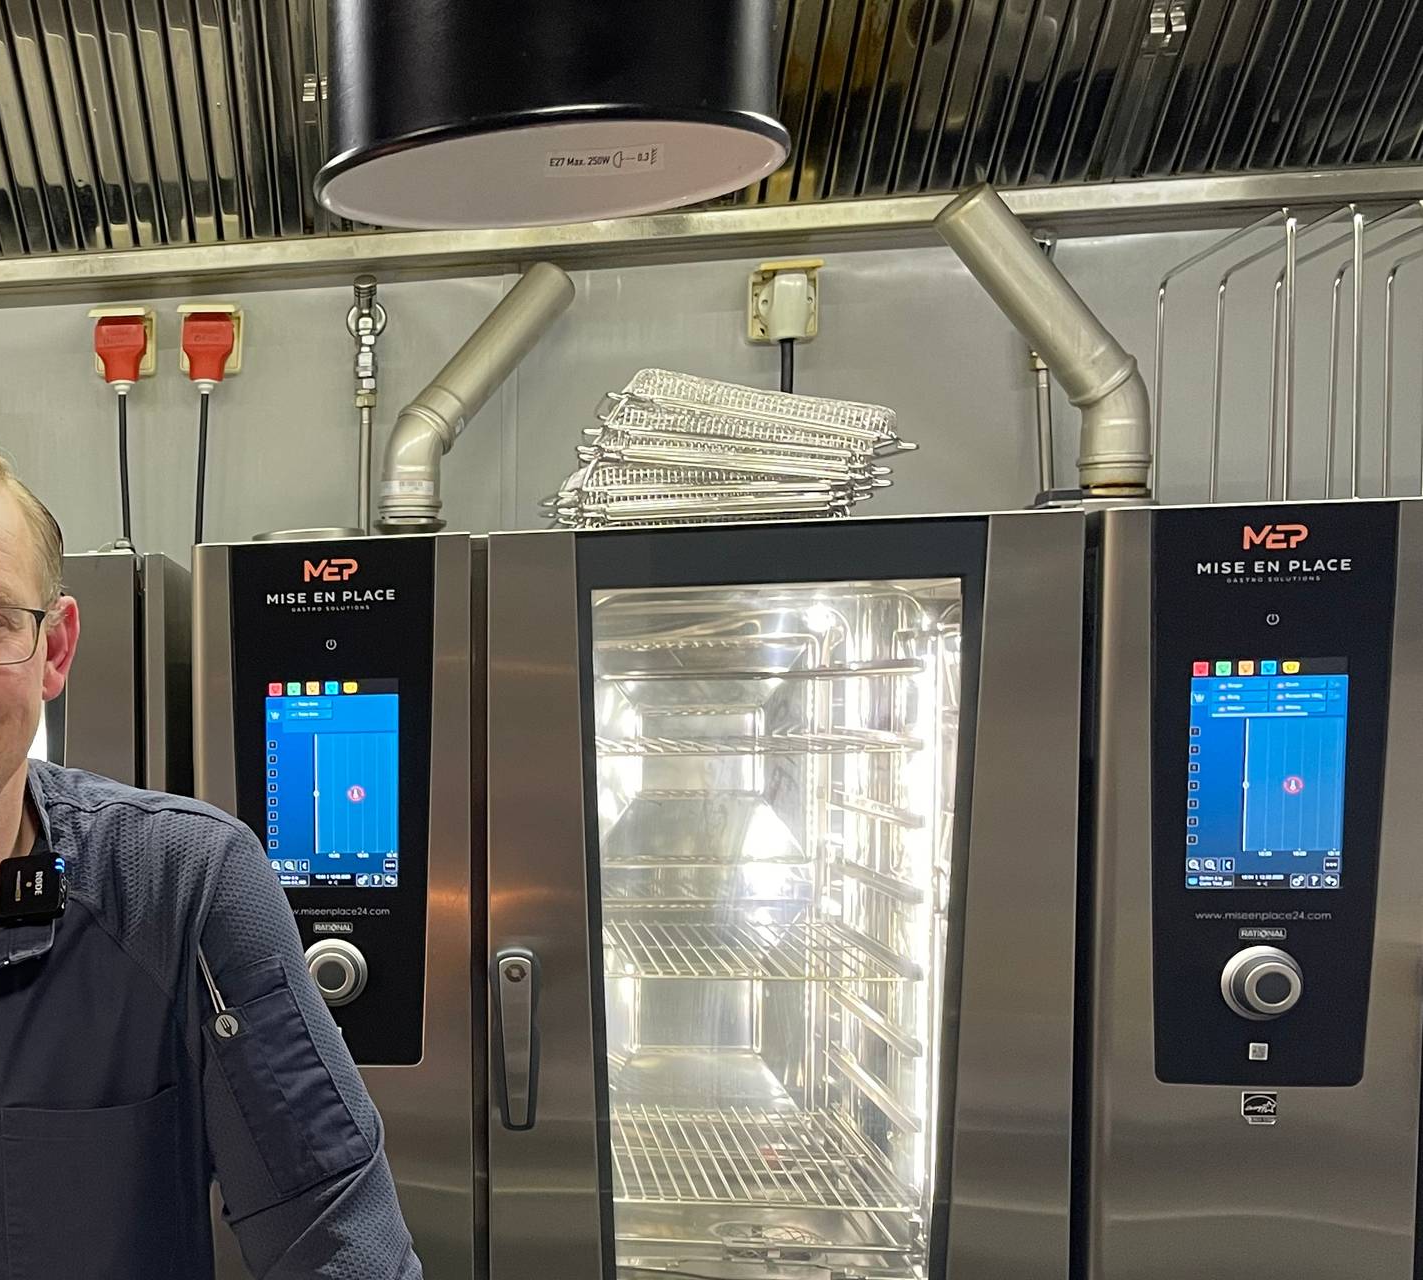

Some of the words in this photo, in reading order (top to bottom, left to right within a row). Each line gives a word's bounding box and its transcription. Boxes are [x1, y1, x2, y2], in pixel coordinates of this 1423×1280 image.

[549, 157, 565, 167] E27
[587, 156, 610, 166] 250W
[1242, 524, 1309, 550] MEP
[303, 558, 359, 582] MEP
[1197, 561, 1245, 575] MISE
[1254, 560, 1280, 573] EN
[1288, 558, 1353, 572] PLACE
[266, 592, 307, 605] MISE
[313, 591, 336, 603] EN
[342, 589, 396, 602] PLACE
[1195, 910, 1333, 921] www.miseenplace24.com
[314, 923, 352, 933] RATIONAL
[1240, 929, 1285, 938] RATIONAL
